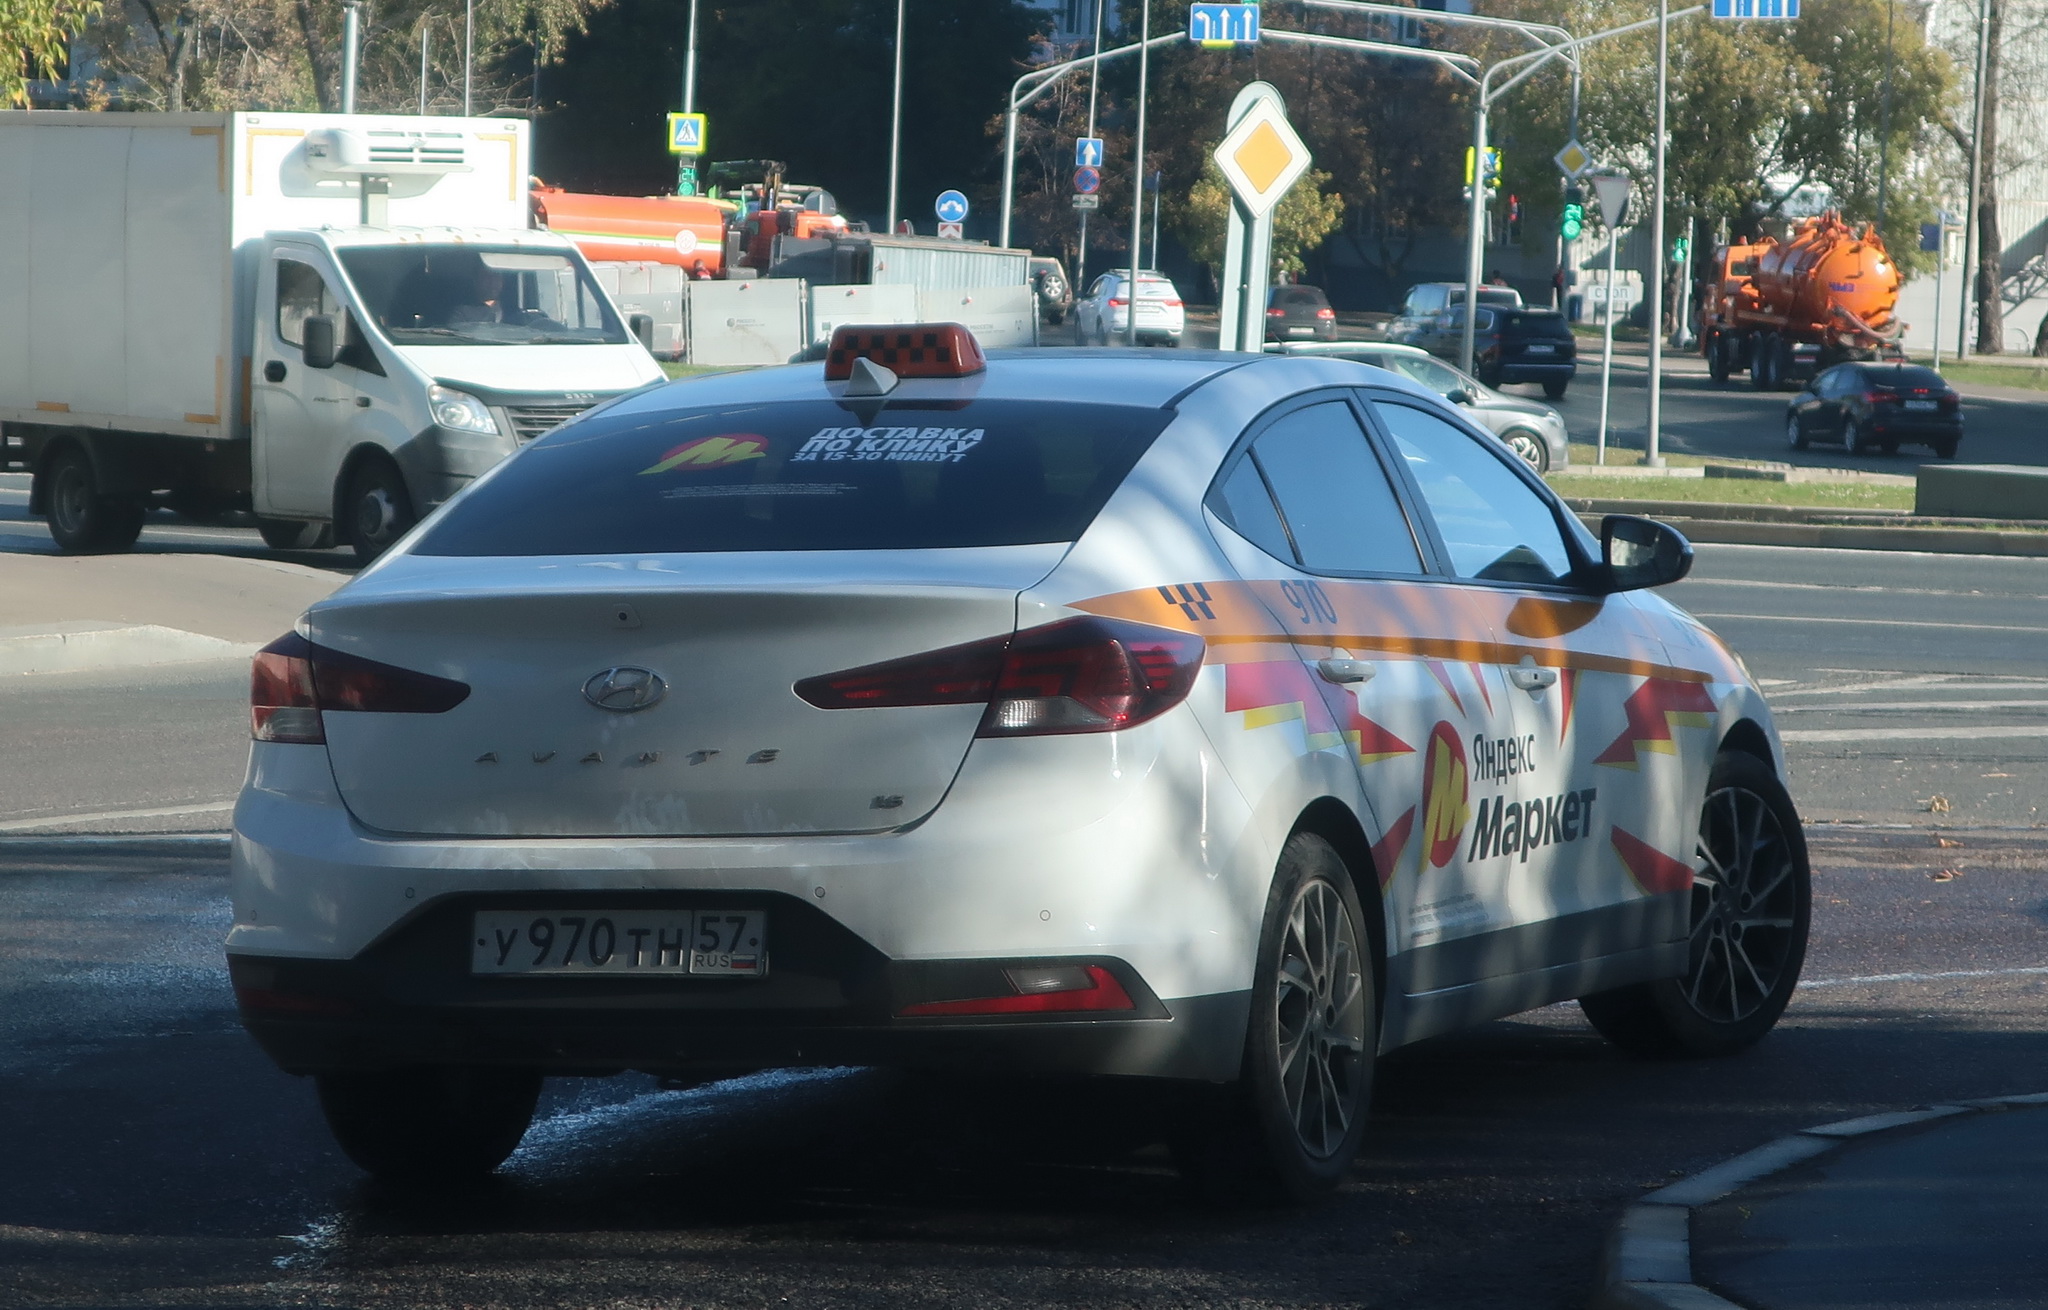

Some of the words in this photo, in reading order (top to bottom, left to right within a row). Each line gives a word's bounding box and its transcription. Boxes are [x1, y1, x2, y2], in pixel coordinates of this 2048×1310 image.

[682, 168, 694, 181] 24
[809, 427, 985, 441] ДОСТАВКА
[799, 438, 853, 453] ПО
[853, 438, 981, 454] КЛИКУ
[790, 451, 818, 462] ЗА
[822, 451, 883, 462] 15-30
[883, 451, 967, 463] МИНУТ
[1280, 580, 1337, 624] 970
[474, 748, 782, 764] AVANTE
[1473, 733, 1536, 785] Яндекс
[1467, 787, 1597, 864] Маркет
[698, 915, 748, 954] 57
[694, 954, 729, 968] RUS
